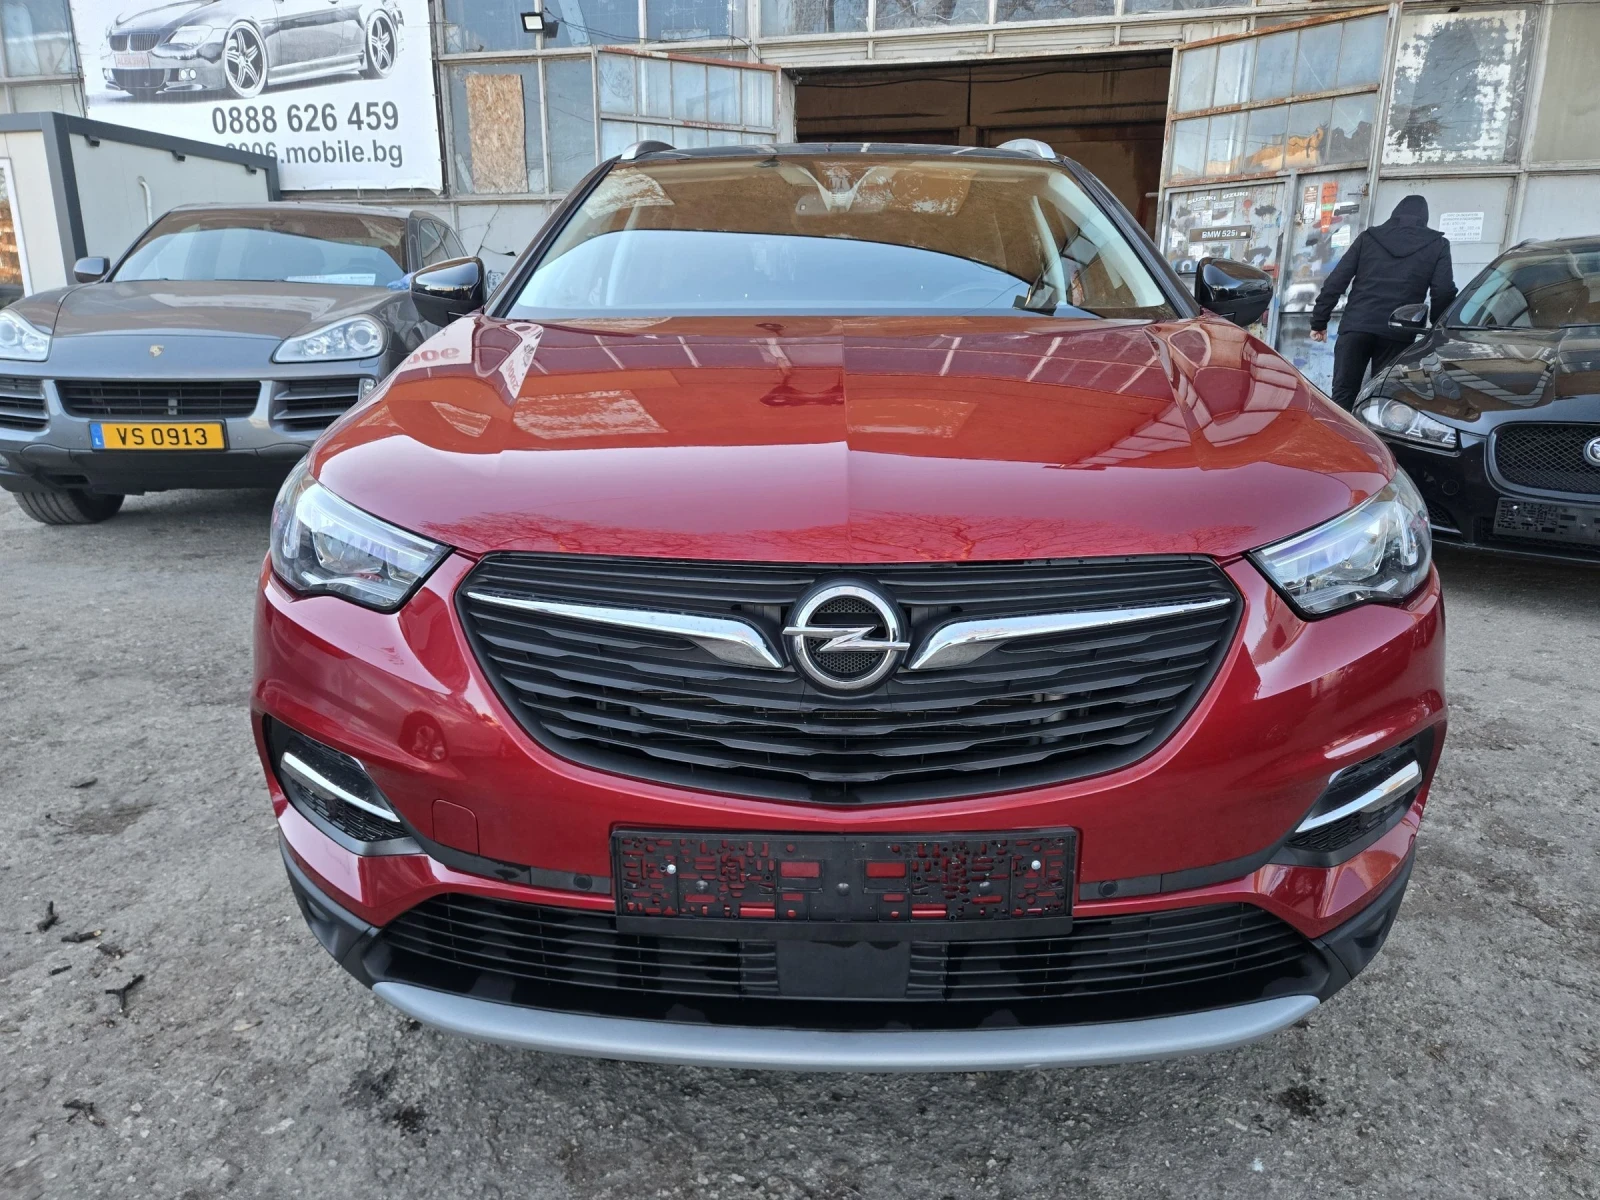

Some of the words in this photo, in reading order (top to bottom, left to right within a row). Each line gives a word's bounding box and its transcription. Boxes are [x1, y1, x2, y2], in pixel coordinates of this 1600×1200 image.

[212, 105, 277, 135] 0888
[287, 103, 337, 132] 626
[347, 101, 399, 131] 459
[1188, 195, 1217, 205] SUZUKI
[1201, 231, 1221, 239] BMW
[116, 427, 145, 446] VS
[151, 427, 208, 446] 0913
